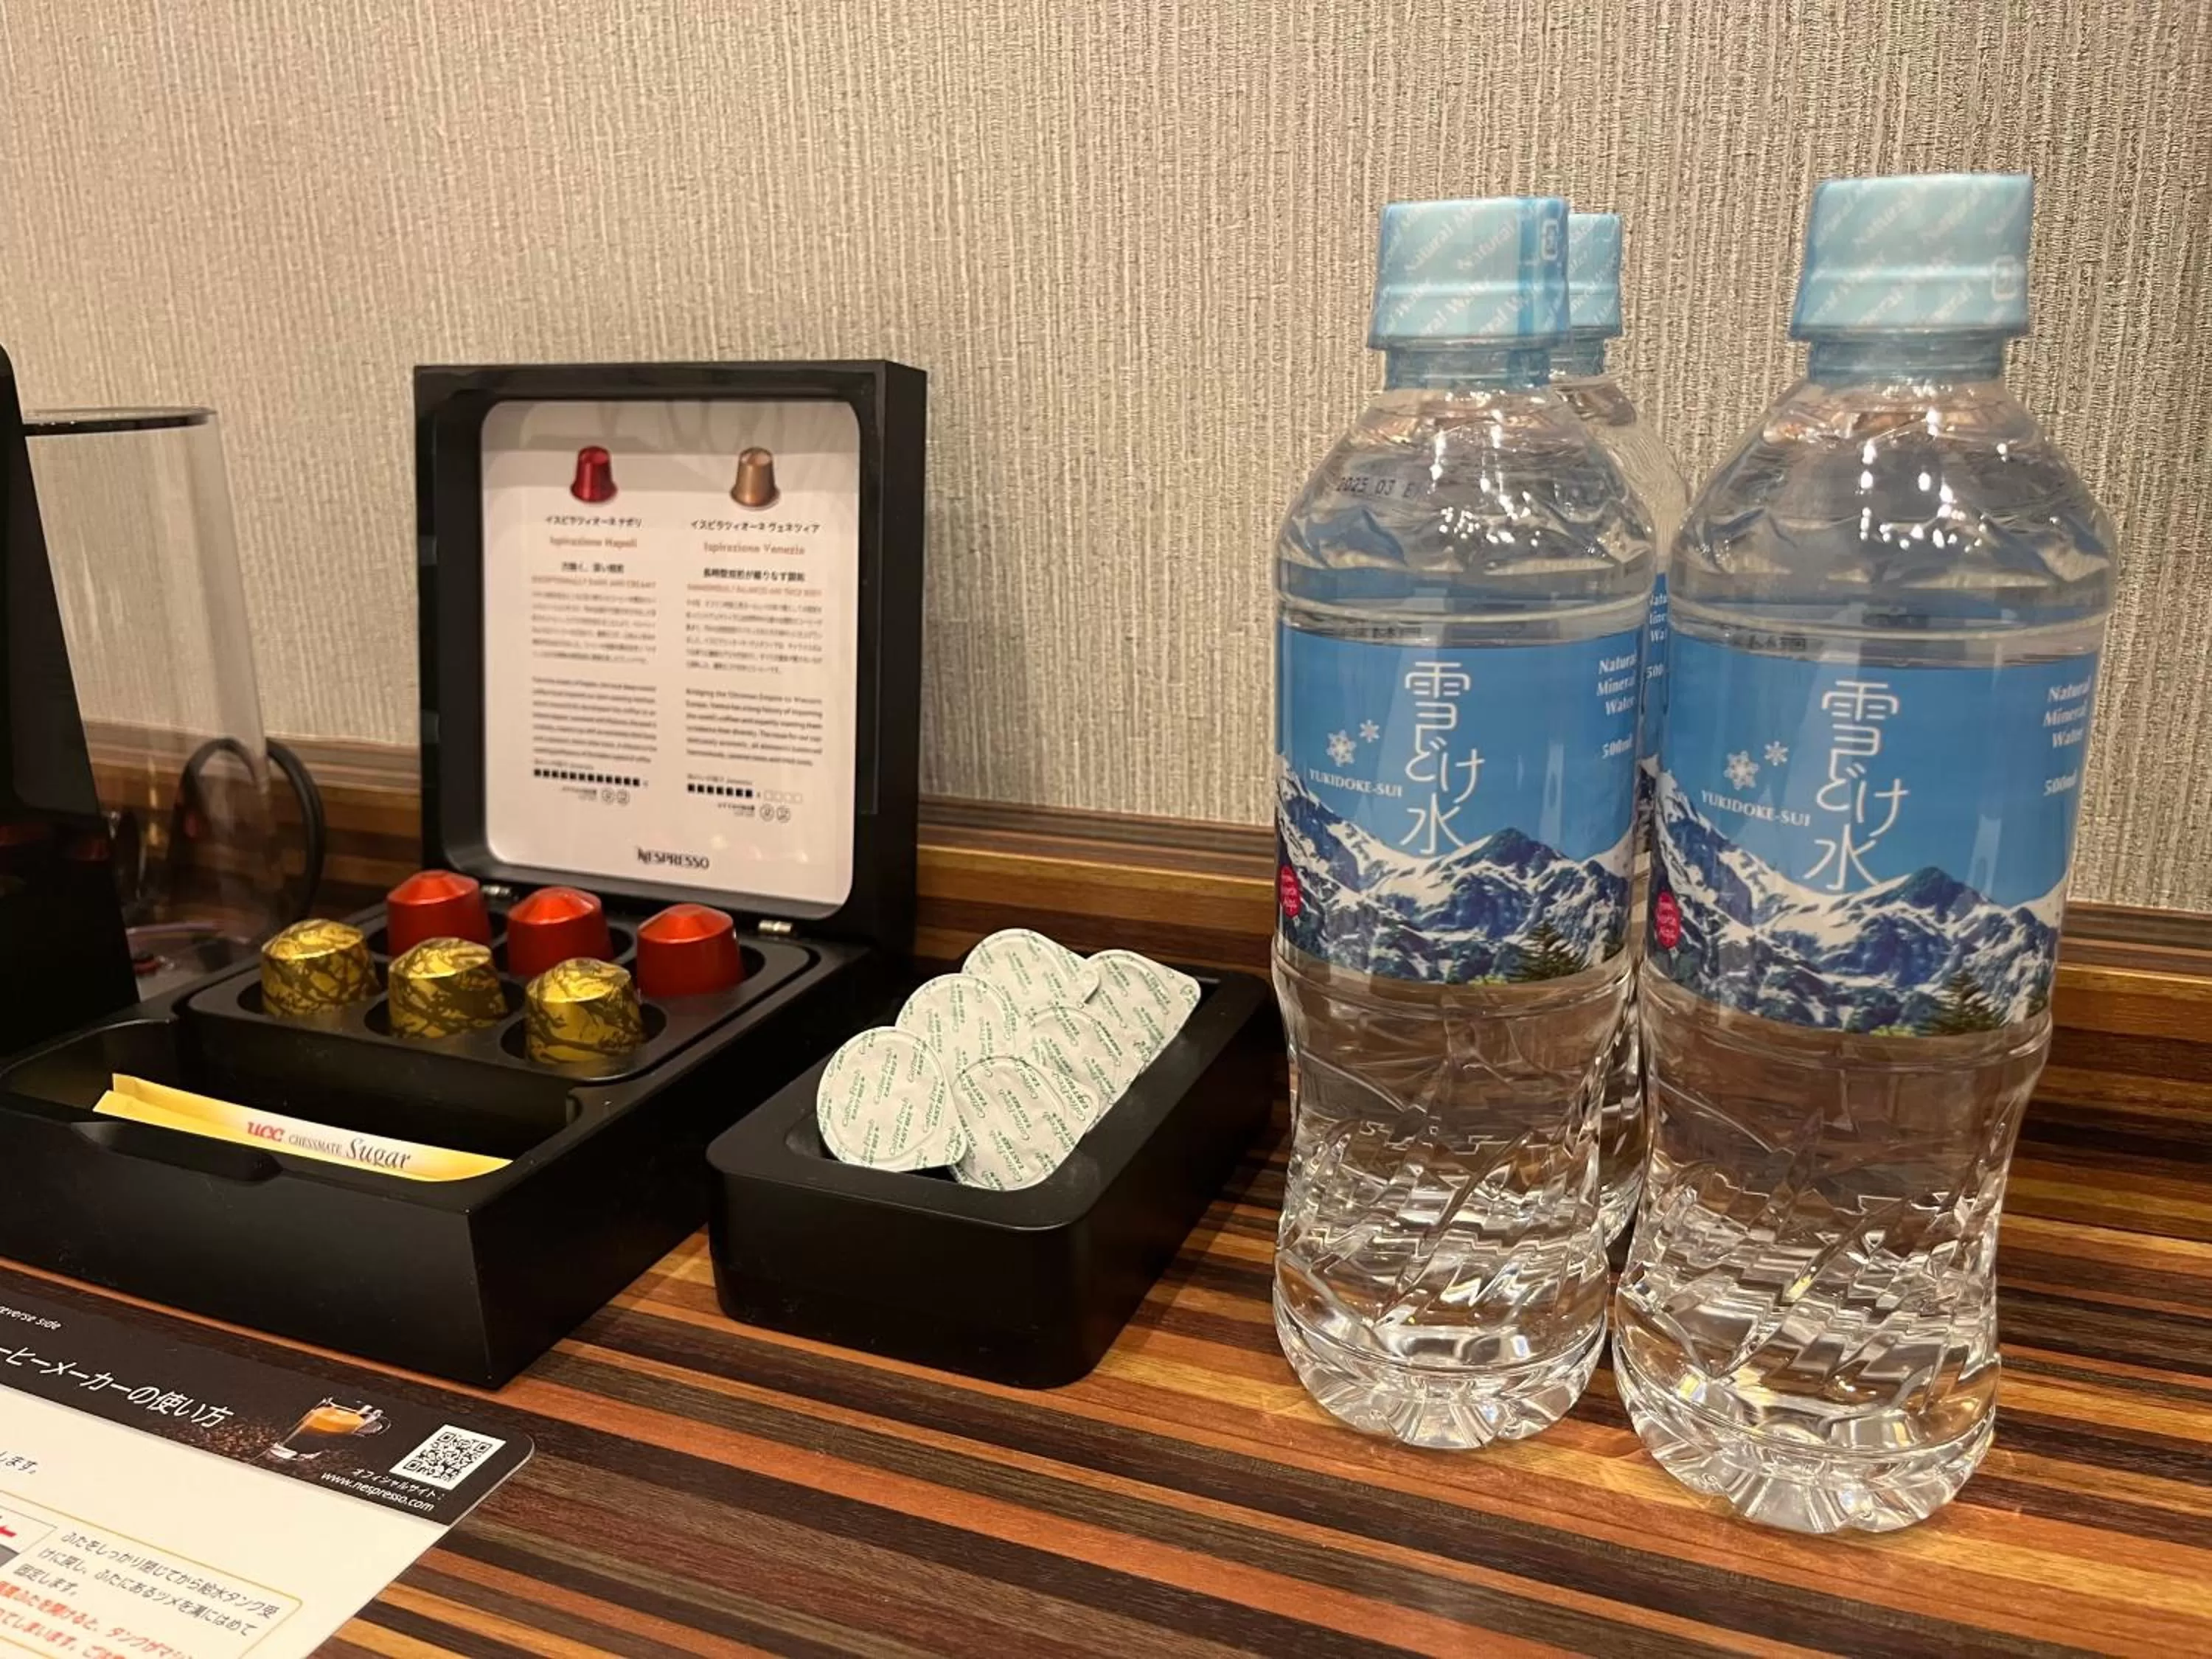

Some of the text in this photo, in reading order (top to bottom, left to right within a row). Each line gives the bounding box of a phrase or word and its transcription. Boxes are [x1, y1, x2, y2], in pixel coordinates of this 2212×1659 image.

[1400, 661, 1485, 855] 雪どけ水
[1309, 767, 1403, 799] YUKIDOKE-SUI
[1804, 680, 1910, 890] 雪どけ水
[1700, 788, 1812, 827] YUKIDOKE-SUI
[636, 848, 710, 870] NESPRESSO
[288, 1133, 344, 1156] CHESSMATE
[345, 1135, 412, 1170] Sugar
[320, 1472, 435, 1512] www.nespresso.com
